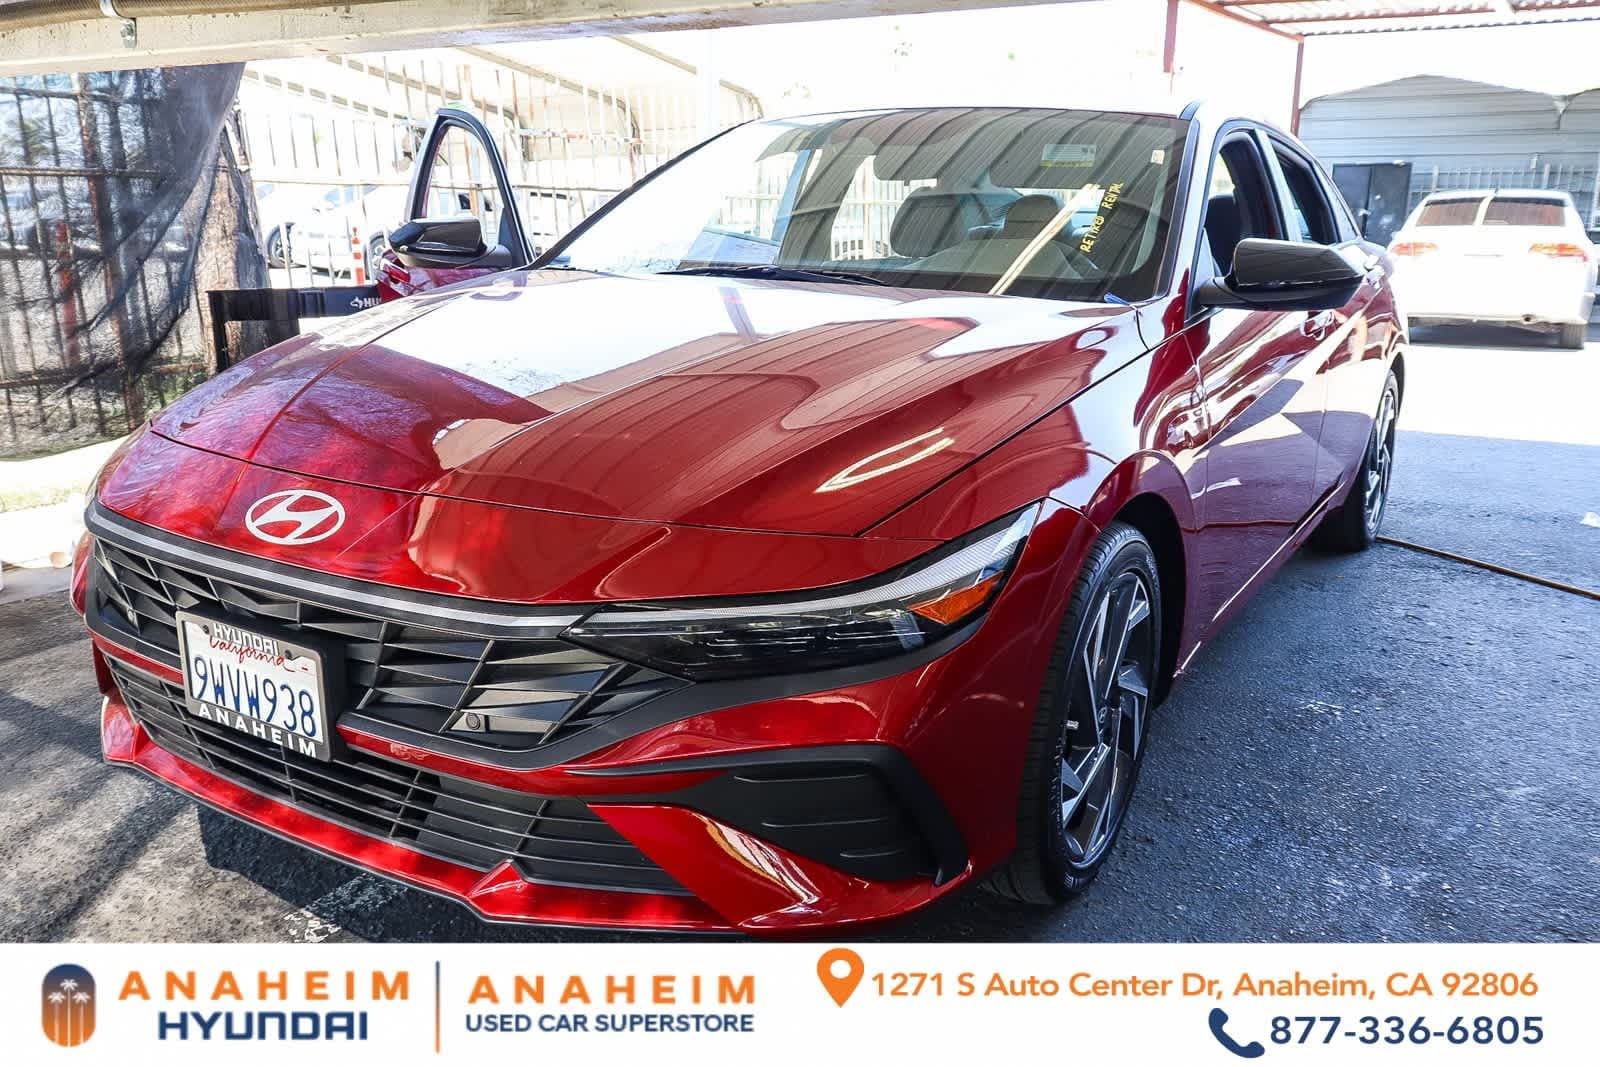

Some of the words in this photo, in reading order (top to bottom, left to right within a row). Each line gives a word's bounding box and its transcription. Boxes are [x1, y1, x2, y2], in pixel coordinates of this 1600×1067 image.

[1101, 182, 1125, 210] RENTAL
[213, 623, 280, 656] HYUNDAI
[194, 656, 317, 738] 9WVW938
[199, 703, 317, 758] ANAHEIM
